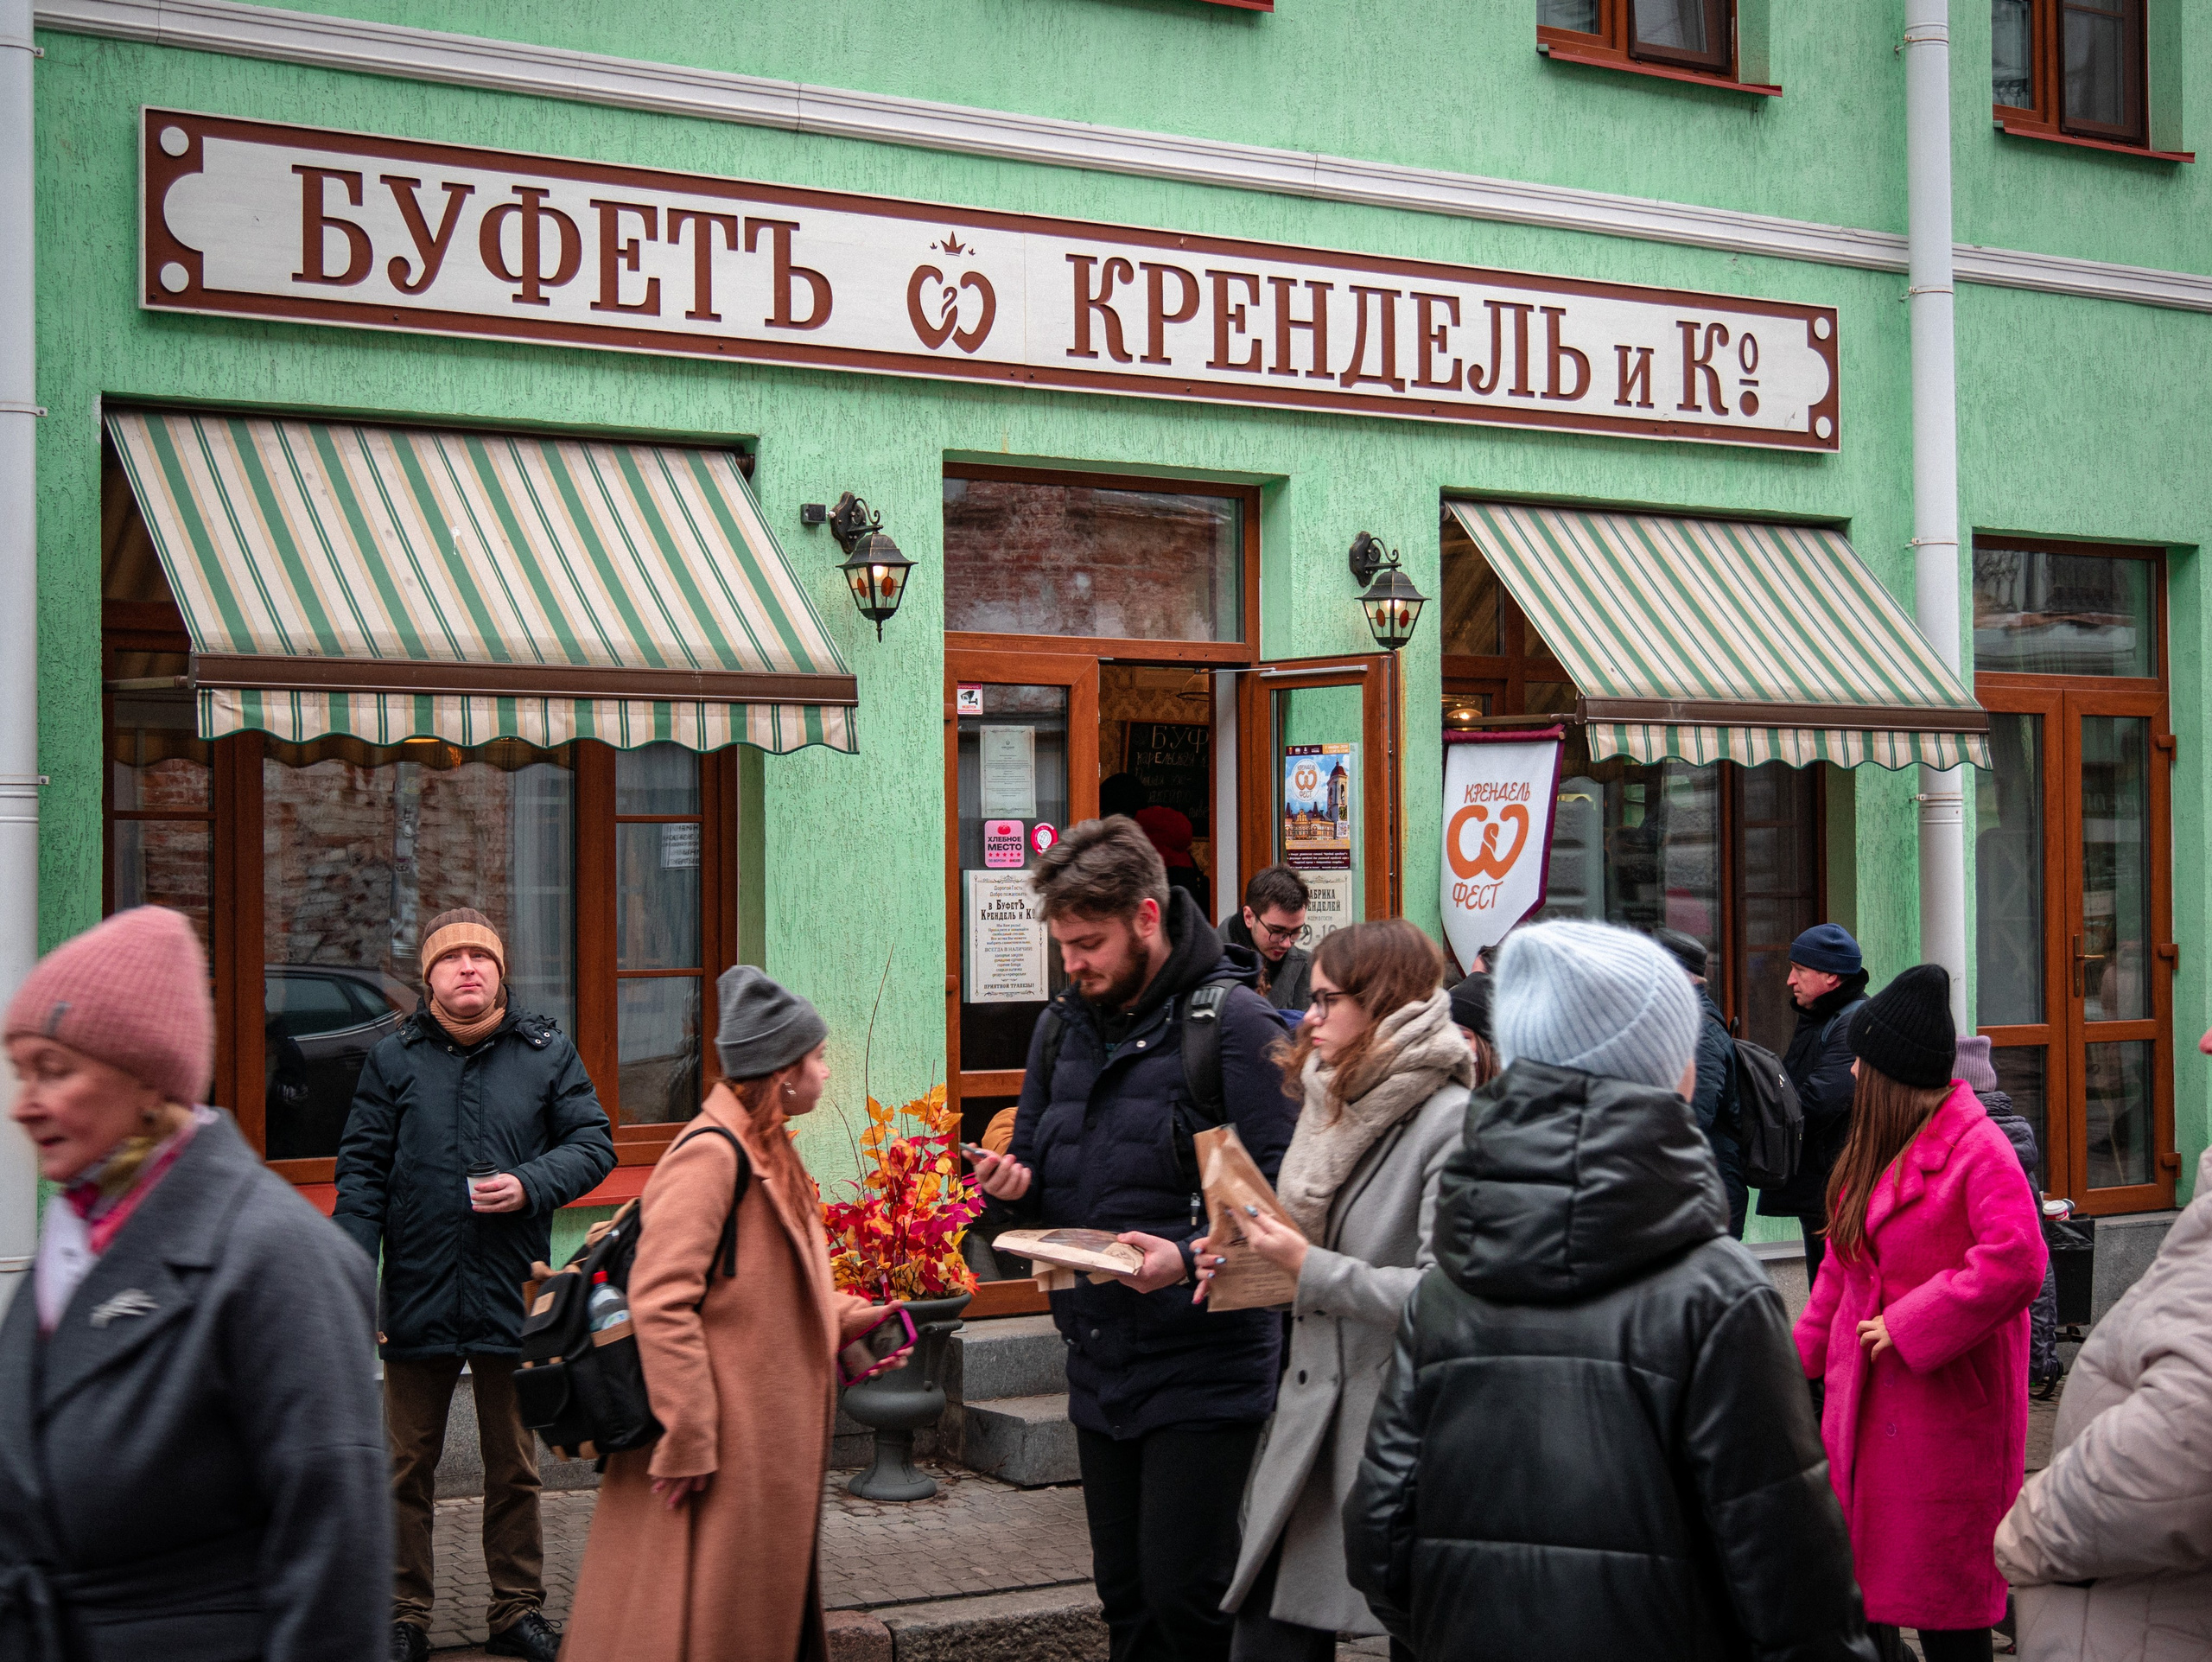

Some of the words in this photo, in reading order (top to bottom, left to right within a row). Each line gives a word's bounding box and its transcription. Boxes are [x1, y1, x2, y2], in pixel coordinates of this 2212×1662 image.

[291, 164, 834, 331] БУФЕТЪ
[1065, 252, 1592, 402] КРЕНДЕЛЬ
[1613, 345, 1655, 410] и
[1464, 781, 1531, 804] КРЕНДЕЛЬ
[1308, 889, 1335, 899] АБРИКА
[1452, 881, 1504, 910] ФЕСТ
